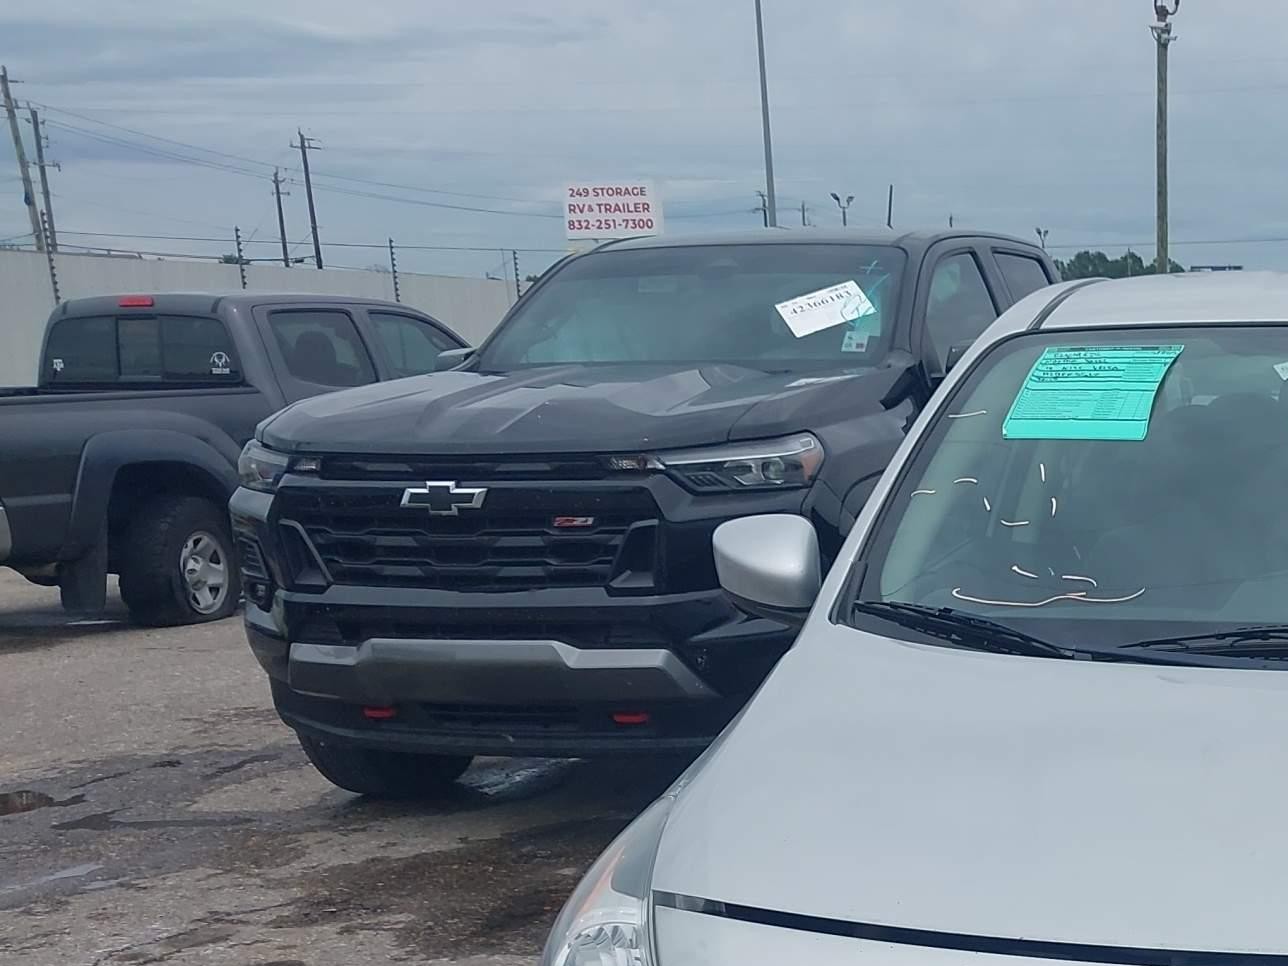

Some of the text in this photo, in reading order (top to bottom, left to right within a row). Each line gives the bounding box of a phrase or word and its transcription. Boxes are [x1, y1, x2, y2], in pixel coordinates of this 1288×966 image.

[568, 186, 647, 198] 249 STORAGE
[568, 203, 585, 214] RV
[596, 202, 650, 213] TRAILER
[567, 218, 654, 230] 832-251-7300
